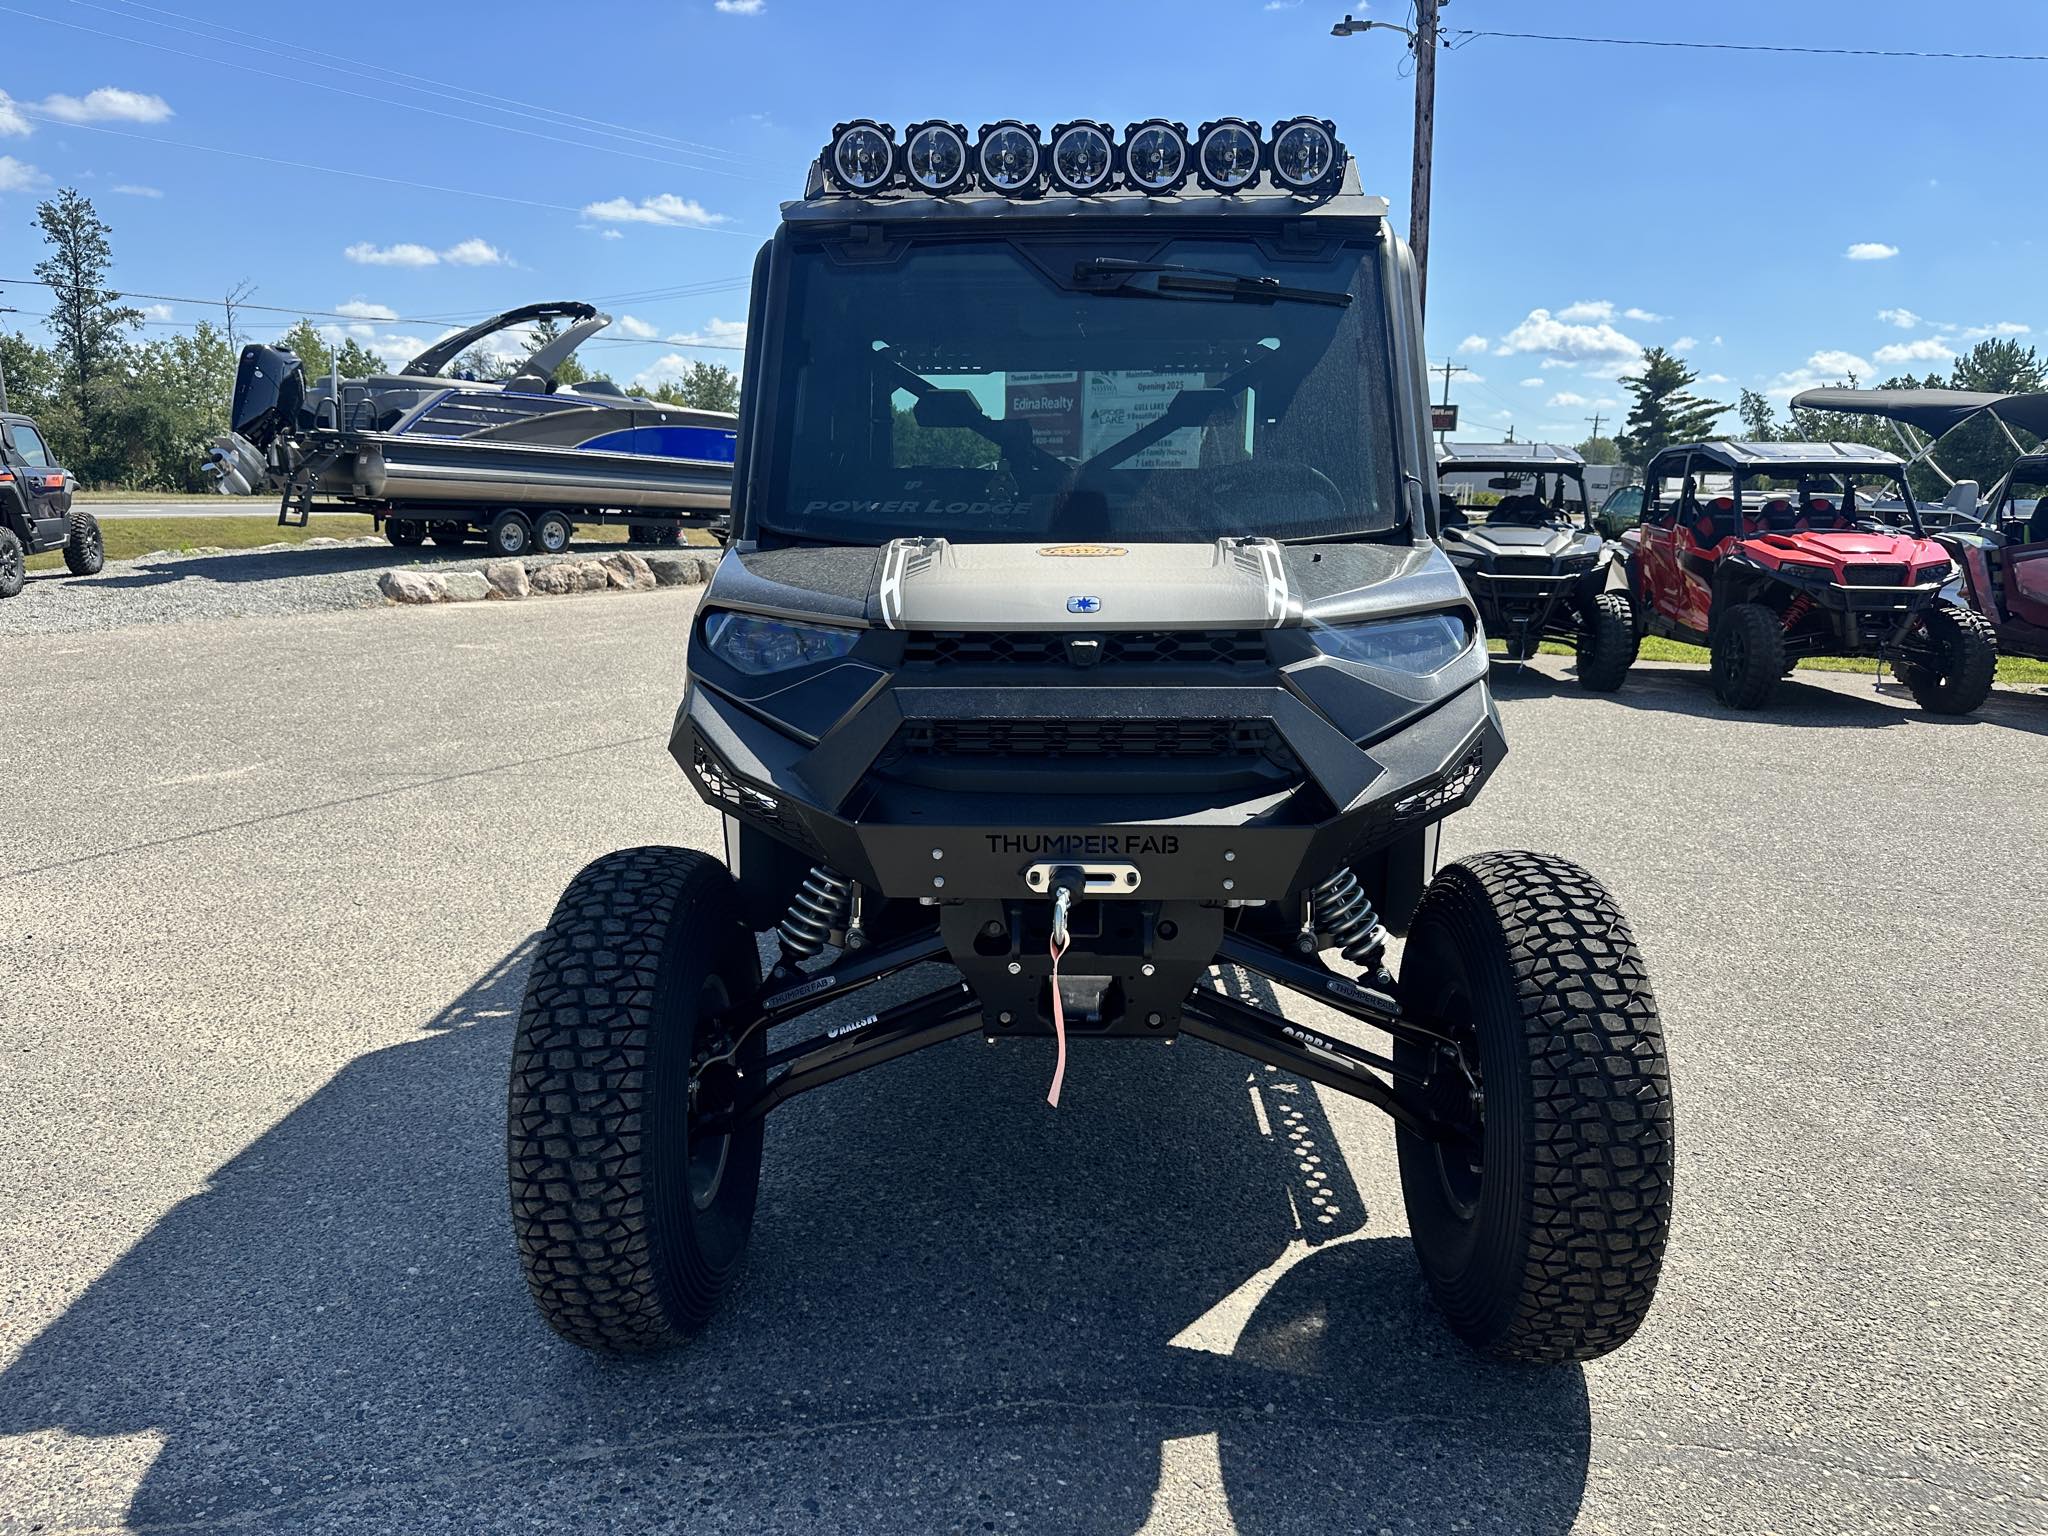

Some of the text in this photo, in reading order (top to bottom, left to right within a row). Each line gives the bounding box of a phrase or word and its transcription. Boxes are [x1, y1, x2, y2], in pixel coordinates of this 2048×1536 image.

[1137, 381, 1166, 393] Opening
[1013, 395, 1074, 413] Edina Realty
[1099, 416, 1125, 425] LAKE
[802, 500, 921, 515] POWER
[985, 835, 1181, 854] THUMPER FAB
[771, 979, 828, 1004] THUMPER FAB
